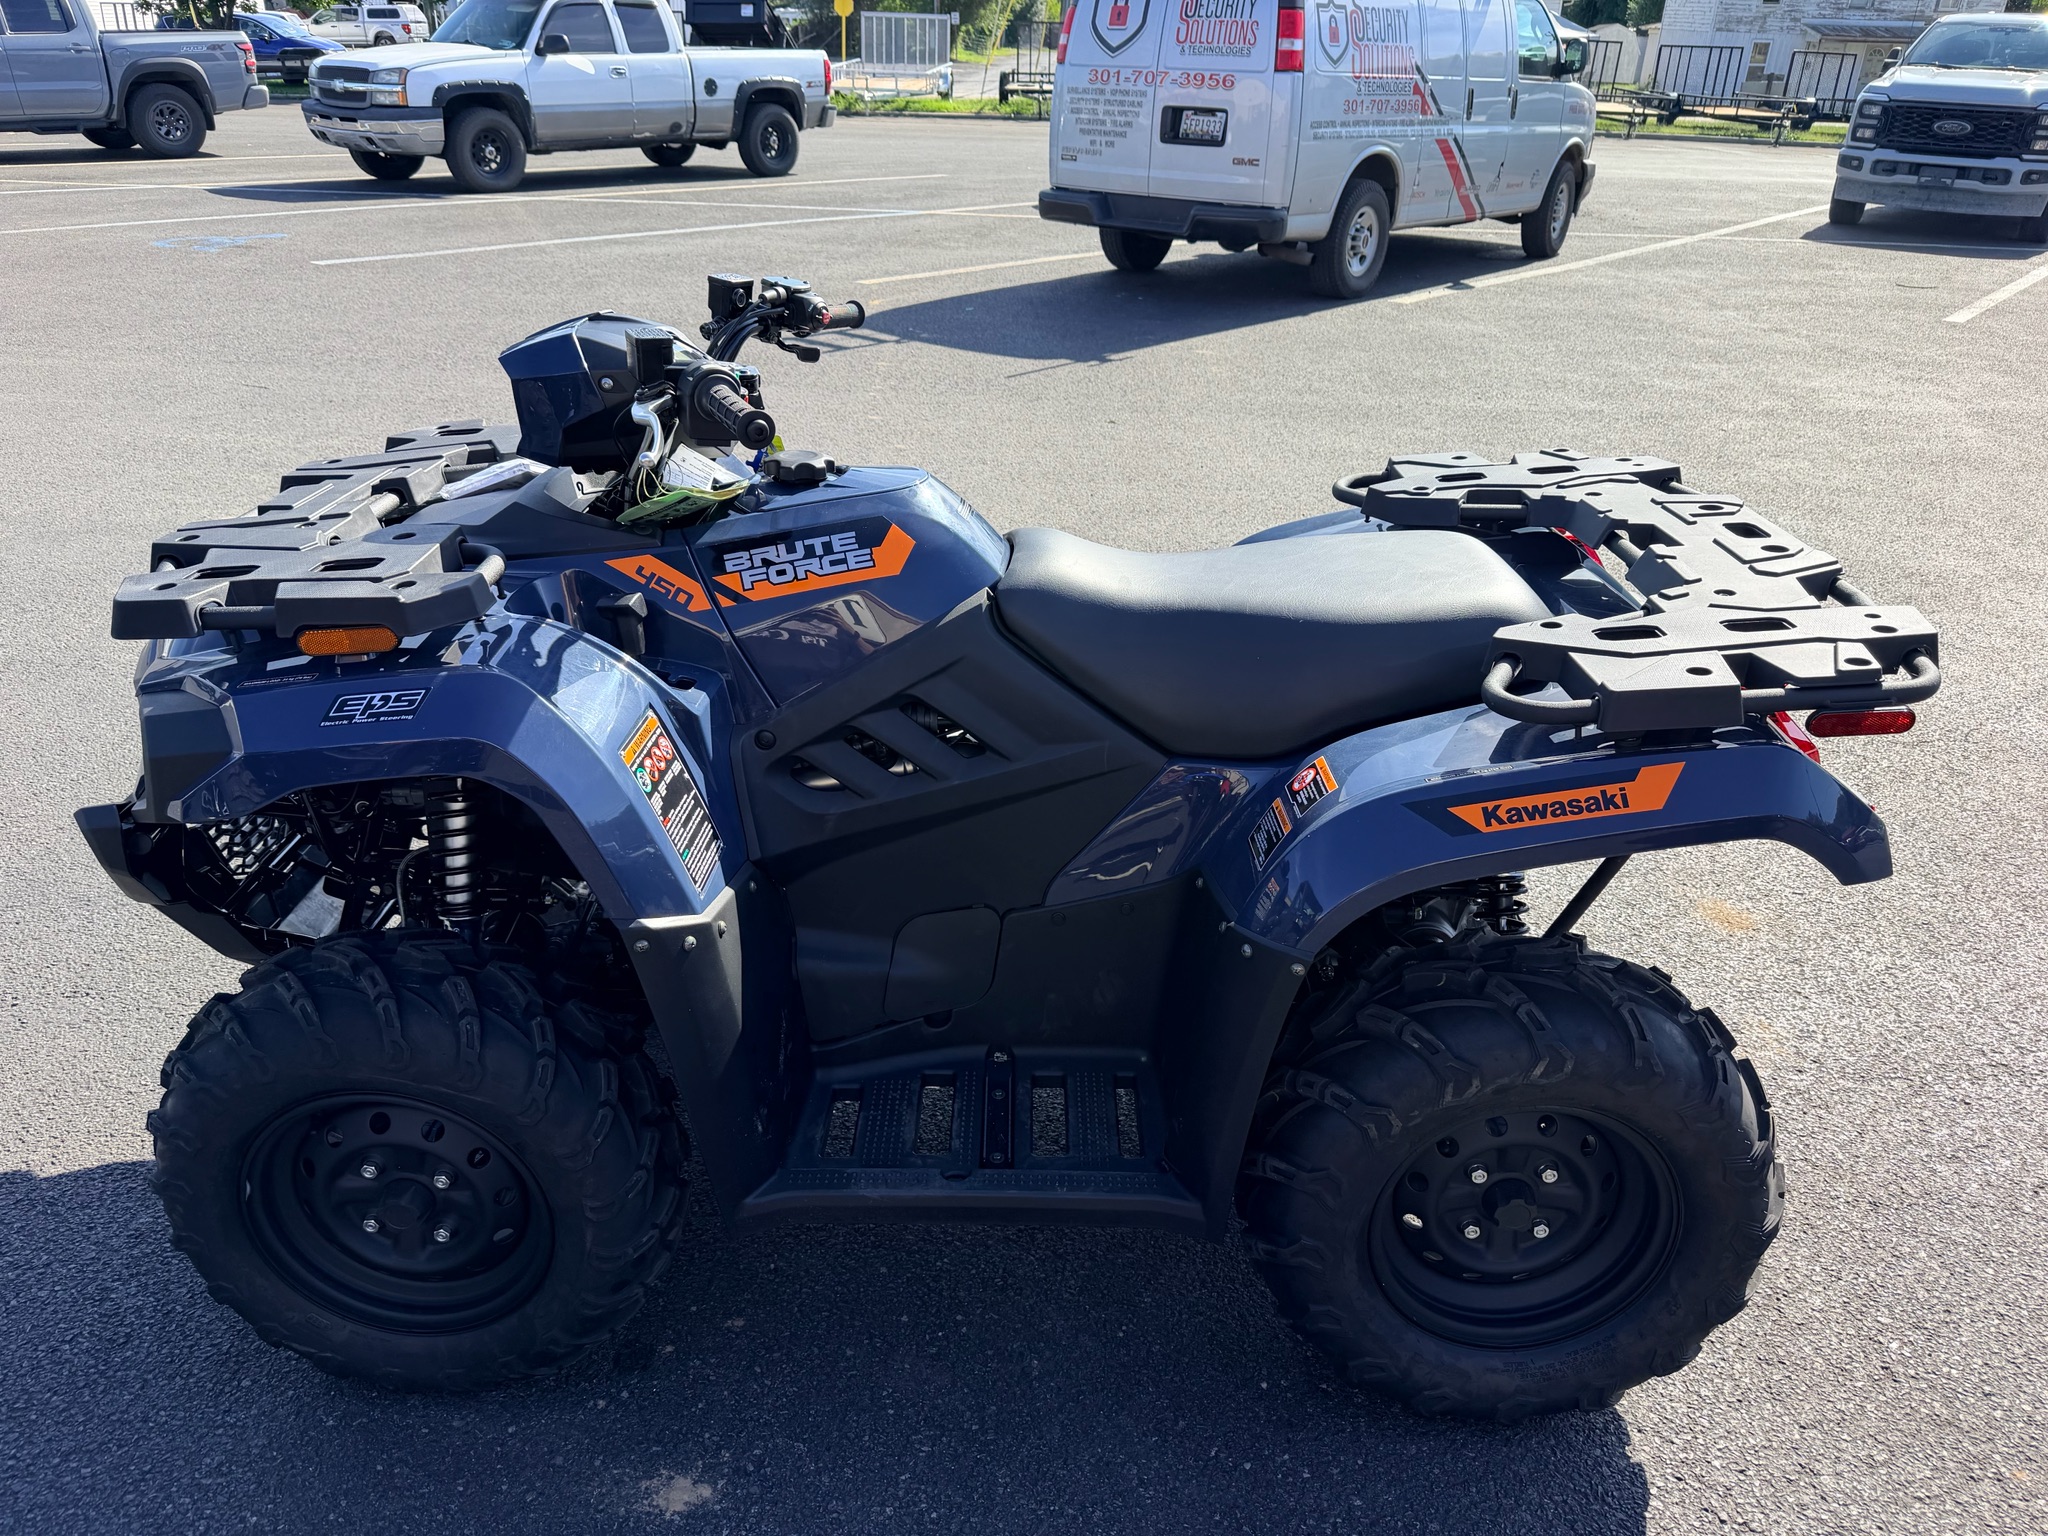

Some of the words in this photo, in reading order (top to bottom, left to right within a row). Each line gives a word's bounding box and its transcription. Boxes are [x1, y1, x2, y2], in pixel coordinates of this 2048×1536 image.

[1175, 8, 1259, 46] SOLUTIONS
[1353, 0, 1408, 43] SECURITY
[1188, 45, 1251, 56] TECHNOLOGIES
[1350, 22, 1415, 80] SOLUTIONS
[1088, 68, 1236, 89] 301-707-3956
[1364, 81, 1411, 95] TECHNOLOGIES
[1343, 99, 1420, 114] 301-707-3956
[1232, 157, 1259, 167] GMC
[723, 531, 859, 572] BRUTE
[741, 548, 875, 590] FORCE
[635, 564, 694, 608] 450
[329, 690, 425, 719] EPS
[320, 719, 349, 727] Electric
[1481, 787, 1629, 827] Kawasaki
